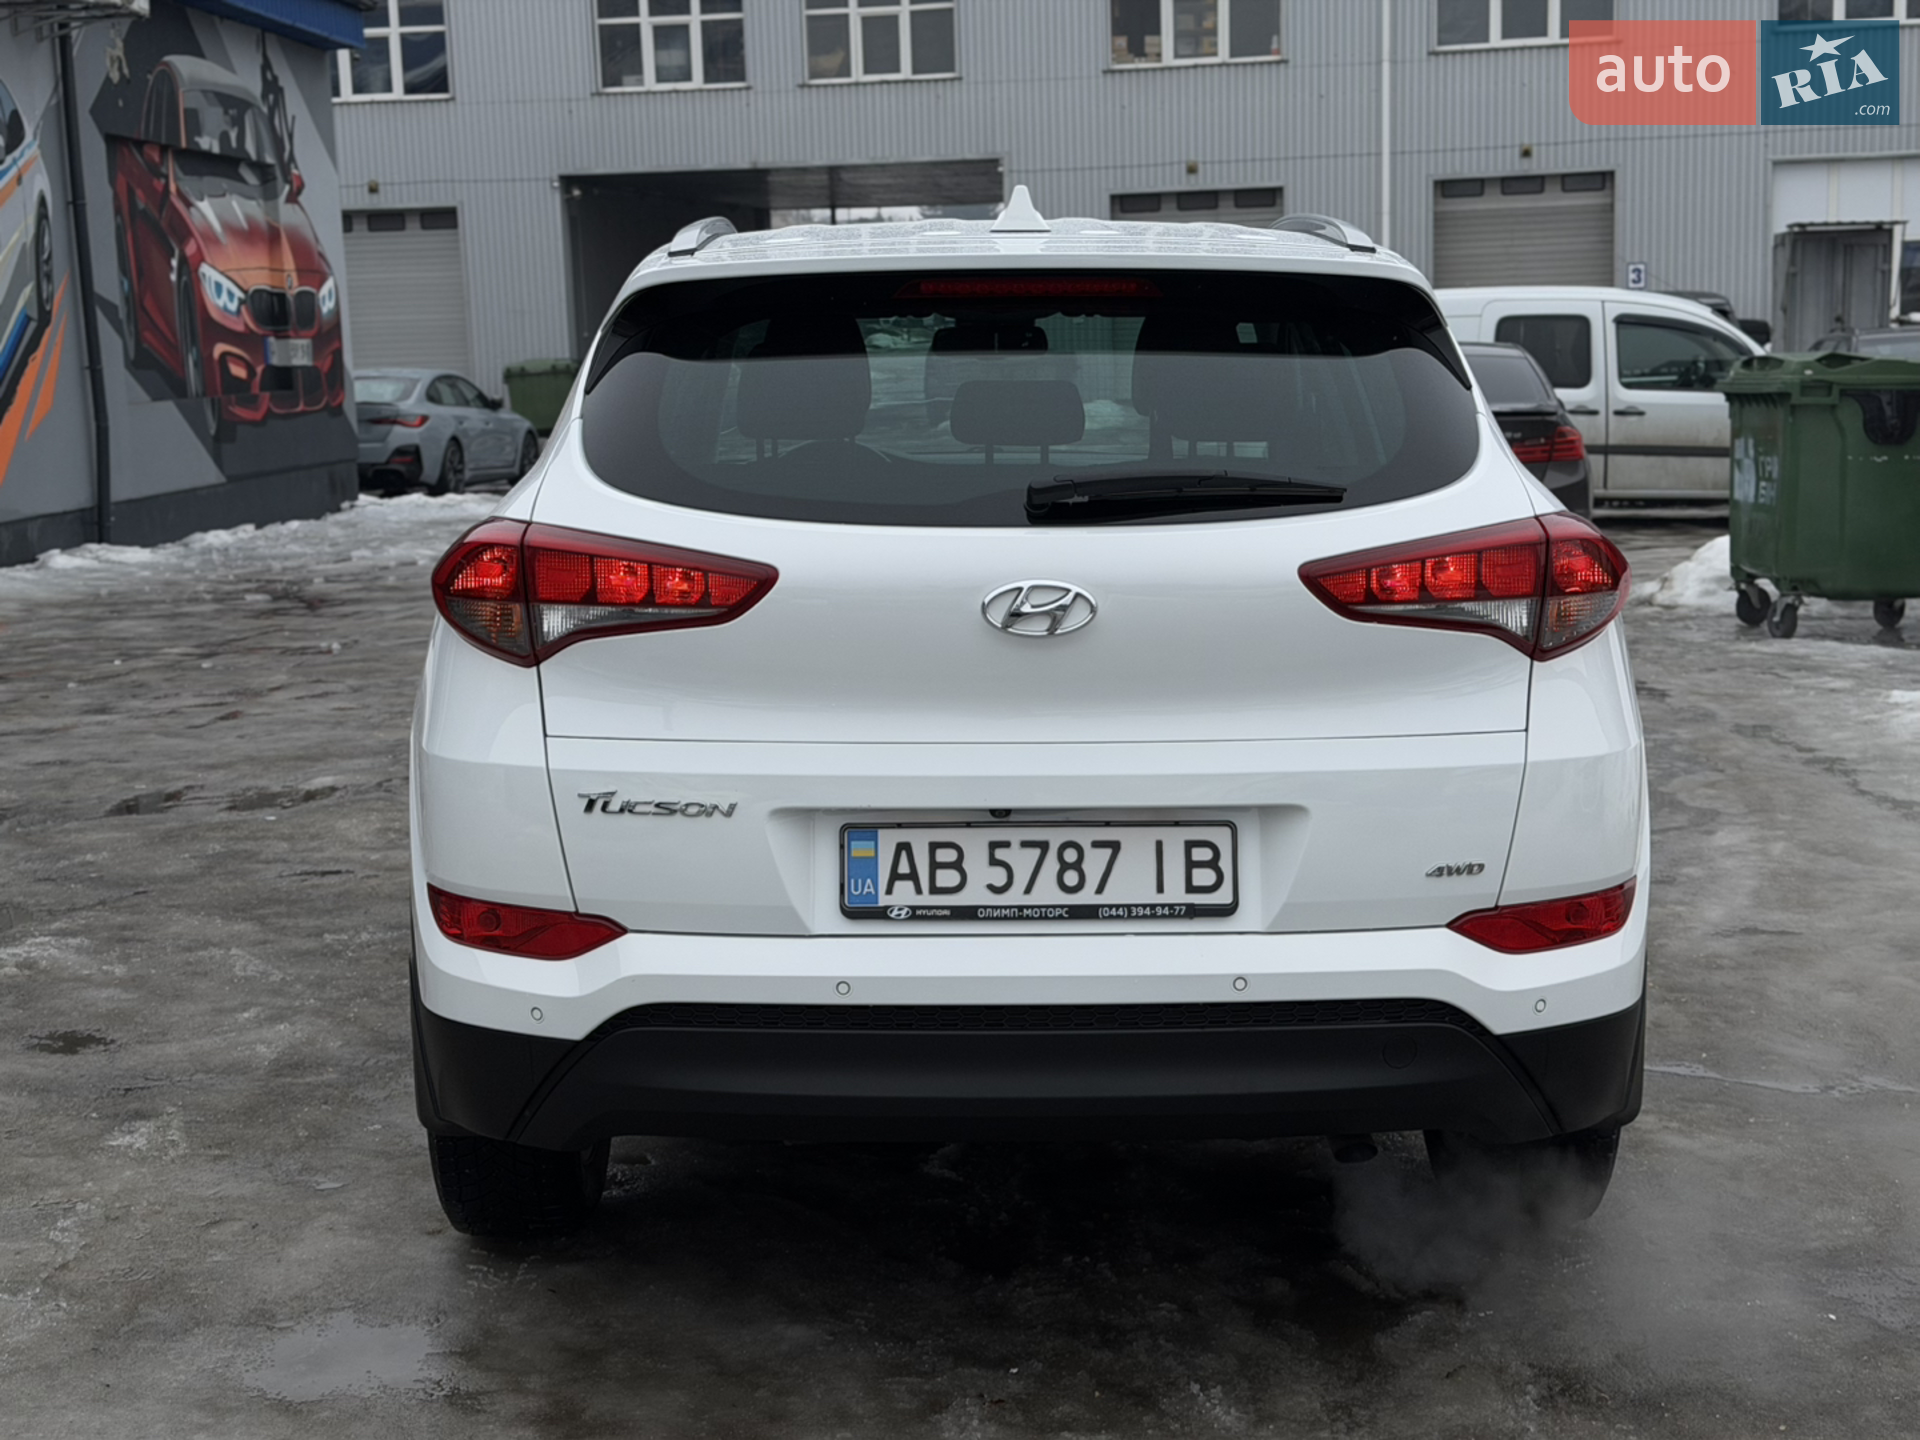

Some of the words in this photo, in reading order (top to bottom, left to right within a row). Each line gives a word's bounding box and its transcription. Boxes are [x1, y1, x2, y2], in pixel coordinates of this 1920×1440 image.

[1631, 267, 1642, 285] 3
[884, 841, 968, 895] AB
[986, 840, 1122, 895] 5787
[1155, 839, 1225, 894] IB
[1425, 862, 1485, 877] 4WD
[850, 878, 875, 895] UA
[915, 908, 951, 916] HYUNDAI
[977, 907, 1069, 918] ОЛИМП-МОТОРС
[1098, 906, 1128, 919] (044)
[1130, 906, 1186, 917] 394-94-77
